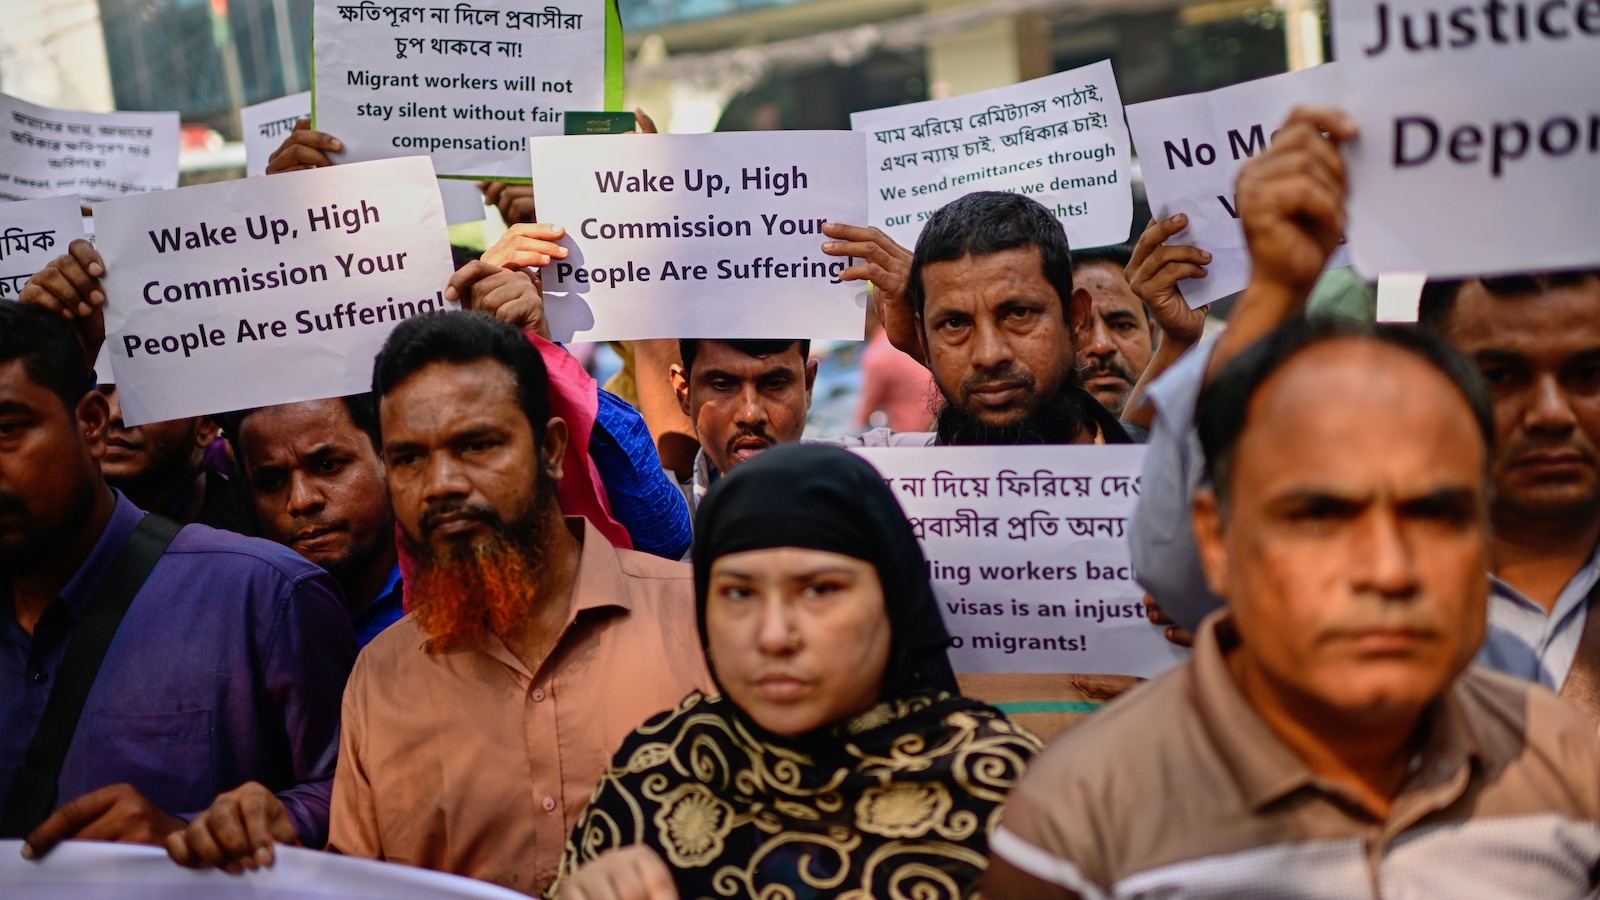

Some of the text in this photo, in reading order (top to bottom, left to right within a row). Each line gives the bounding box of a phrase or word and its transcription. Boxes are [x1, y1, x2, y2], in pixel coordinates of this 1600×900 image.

[337, 3, 582, 30] ক্ষতিপূরণ না দিলে প্রবাসীরা
[395, 37, 522, 58] চুপ থাকবে না!
[347, 70, 573, 93] Migrant workers will not
[357, 102, 562, 123] stay silent without fair
[874, 128, 906, 144] ঘাম
[910, 116, 964, 139] ঝরিয়ে
[969, 99, 1047, 128] রেমিট্যান্স
[392, 137, 526, 152] compensation!
[880, 156, 918, 172] এখন
[1000, 122, 1069, 148] অধিকার
[1072, 112, 1108, 132] চাই!
[1163, 138, 1216, 170] No
[595, 165, 808, 197] Wake Up, High
[880, 143, 1116, 201] We send remittances through
[1021, 181, 1045, 194] we
[1050, 170, 1118, 191] demand
[149, 200, 380, 254] Wake Up, High
[581, 214, 827, 240] Commission Your
[885, 214, 912, 227] our
[143, 251, 407, 305] Commission Your
[557, 261, 651, 288] People
[660, 260, 708, 281] Are
[123, 291, 446, 357] People Are Suffering!
[900, 478, 925, 497] না
[932, 470, 990, 498] দিয়ে
[997, 470, 1092, 498] ফিরিয়ে
[1008, 510, 1059, 541] প্রতি
[979, 561, 1077, 580] workers
[947, 598, 1004, 616] visas
[1011, 599, 1029, 616] is
[1038, 602, 1066, 618] an
[972, 633, 1087, 654] migrants!
